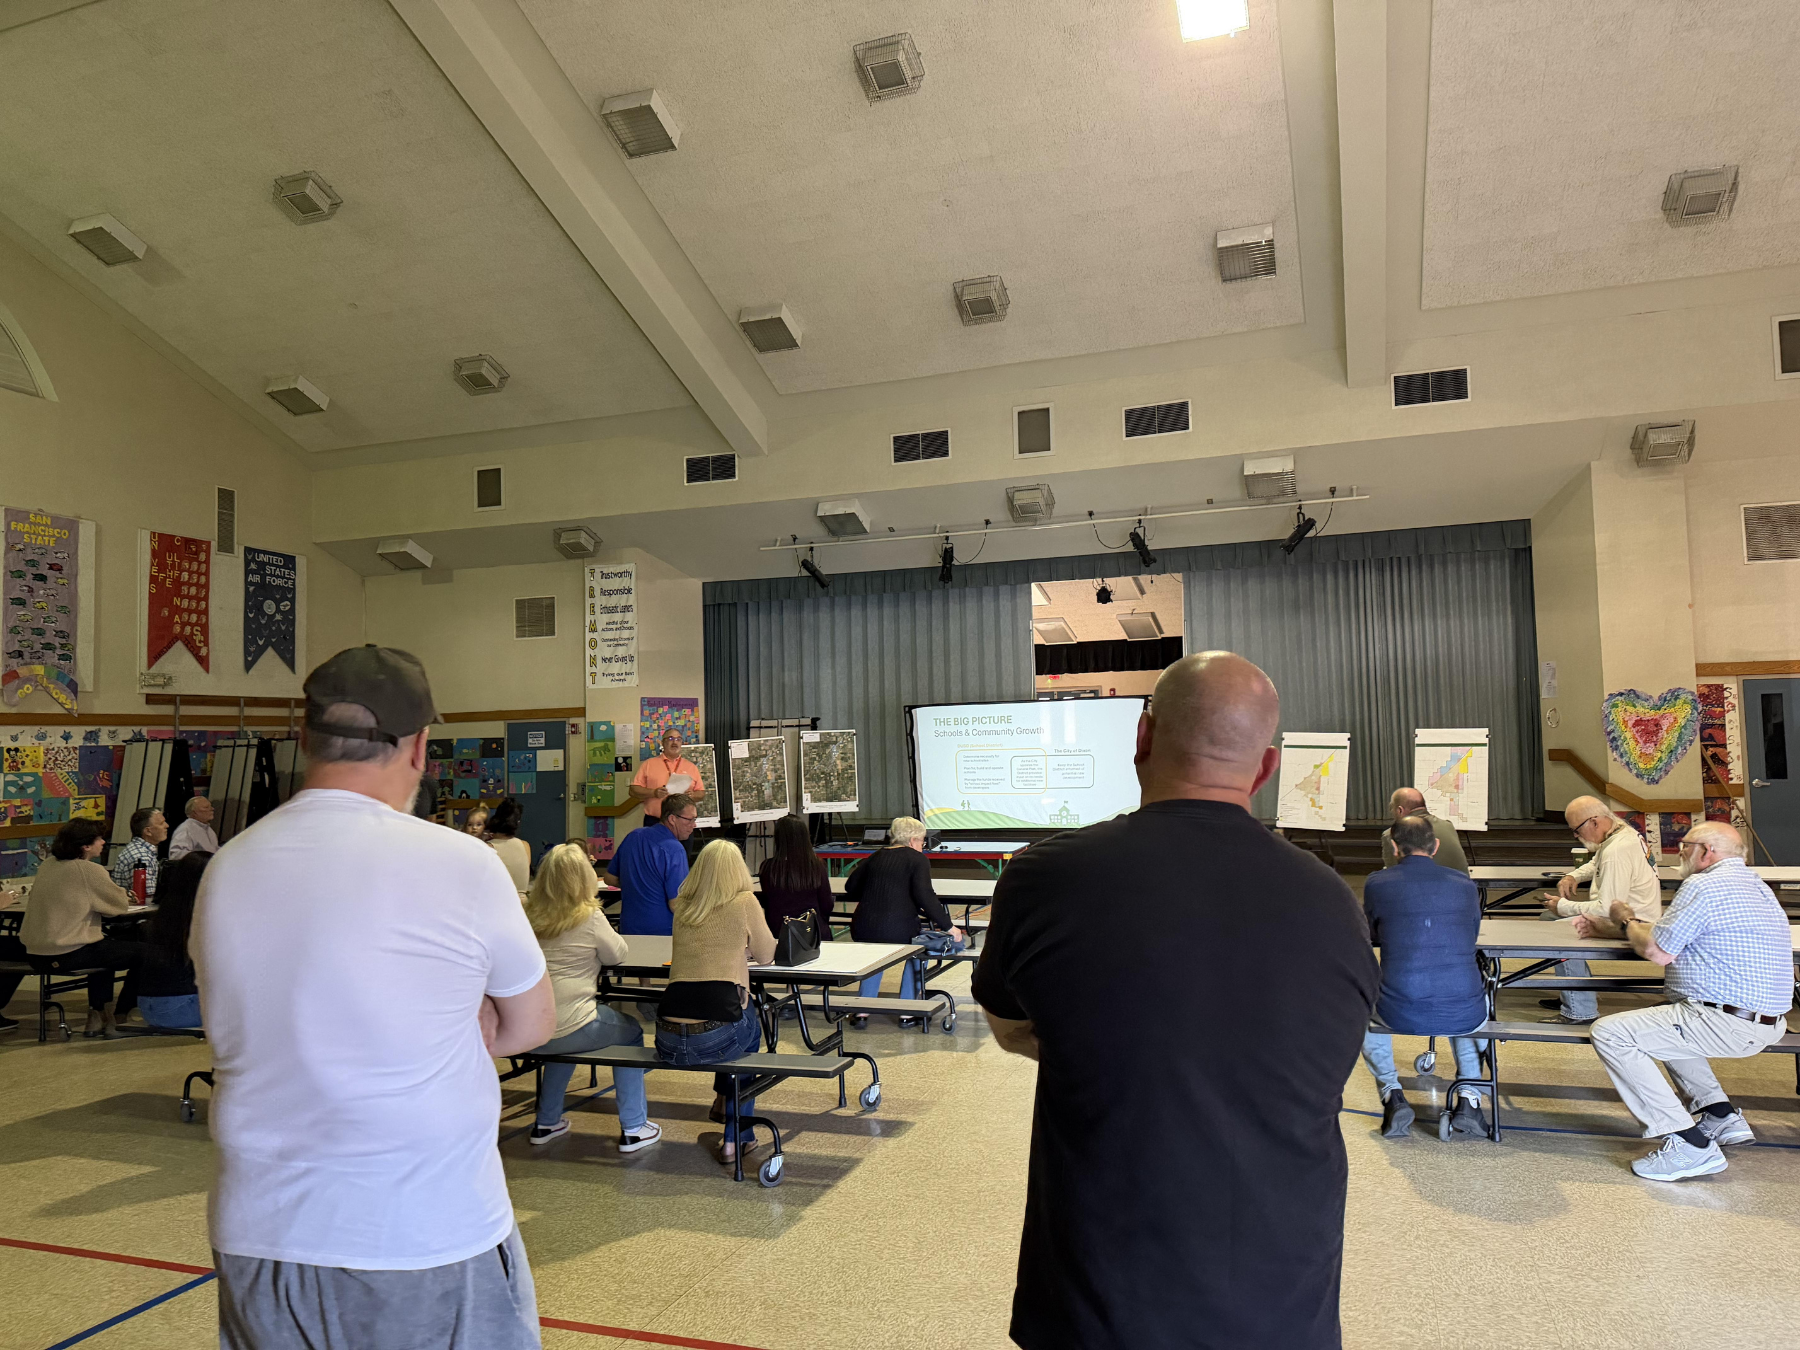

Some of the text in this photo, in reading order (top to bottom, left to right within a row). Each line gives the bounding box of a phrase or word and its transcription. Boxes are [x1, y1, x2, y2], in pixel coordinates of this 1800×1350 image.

[30, 514, 51, 525] SAN
[11, 521, 69, 539] FRANCISCO
[24, 534, 56, 547] STATE
[255, 552, 284, 566] UNITED
[265, 565, 296, 579] STATES
[600, 569, 633, 580] Trustworthy
[248, 573, 294, 588] AIR FORCE
[600, 586, 633, 598] Responsible
[601, 654, 635, 665] Never Giving Up
[18, 684, 33, 698] GO
[933, 715, 1012, 726] THE BIG PICTURE
[934, 729, 963, 737] Schools
[972, 728, 1014, 737] Community
[1016, 727, 1044, 735] Growth
